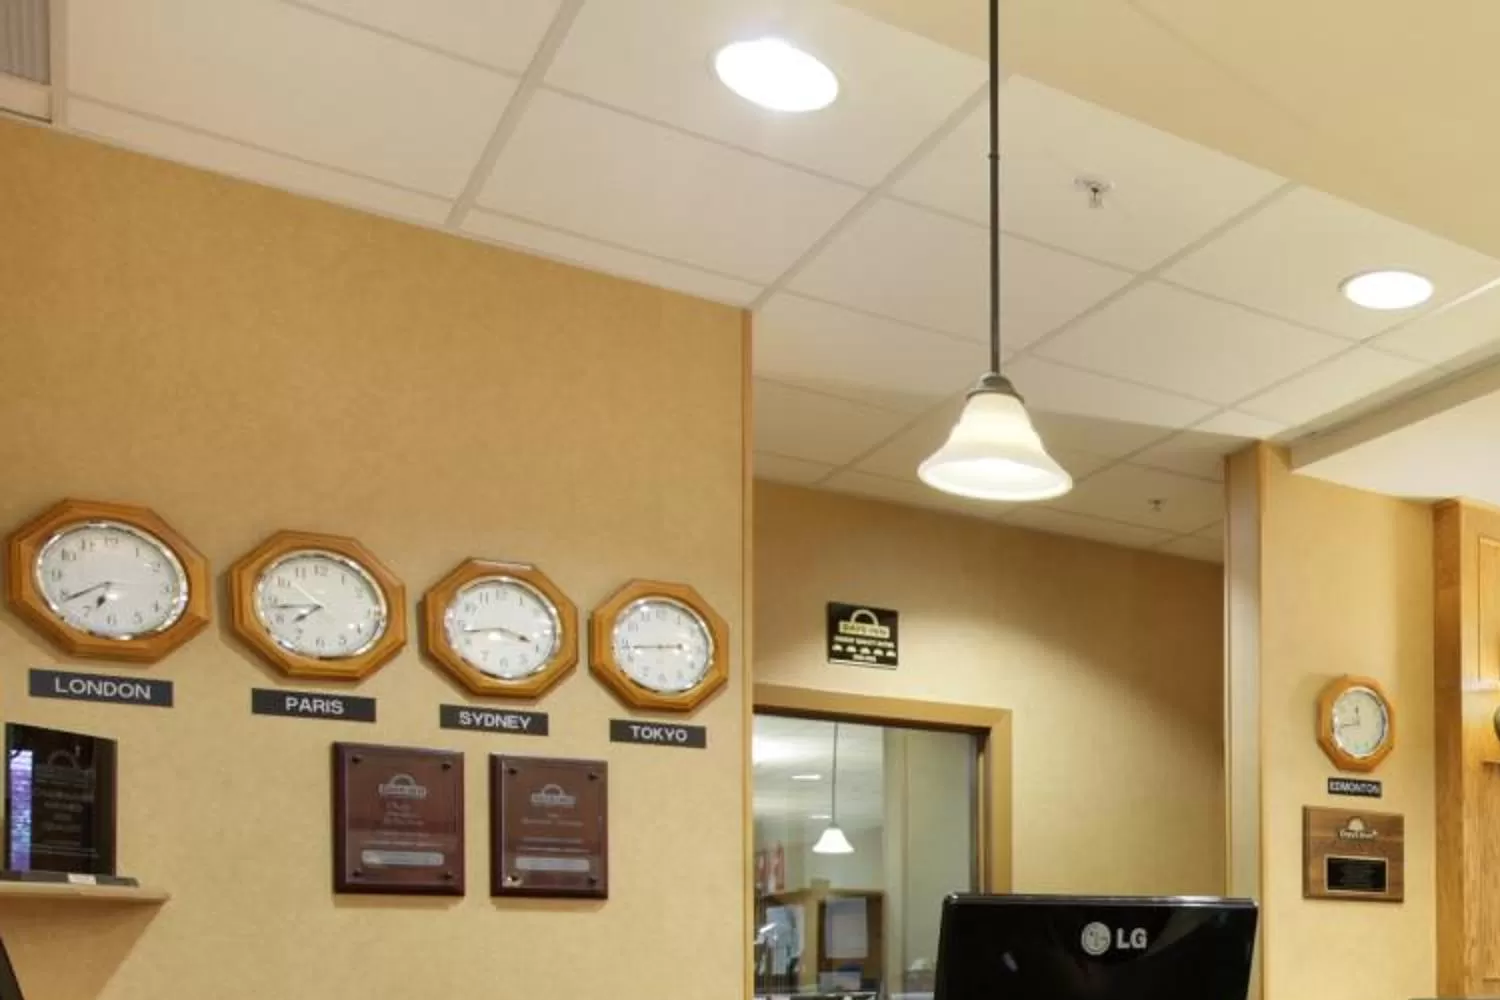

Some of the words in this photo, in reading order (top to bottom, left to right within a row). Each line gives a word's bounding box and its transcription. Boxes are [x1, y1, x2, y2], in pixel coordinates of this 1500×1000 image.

[55, 677, 152, 699] LONDON
[285, 696, 344, 714] PARIS
[459, 711, 532, 729] SYDNEY
[628, 725, 688, 742] TOKYO
[1116, 928, 1147, 949] LG
